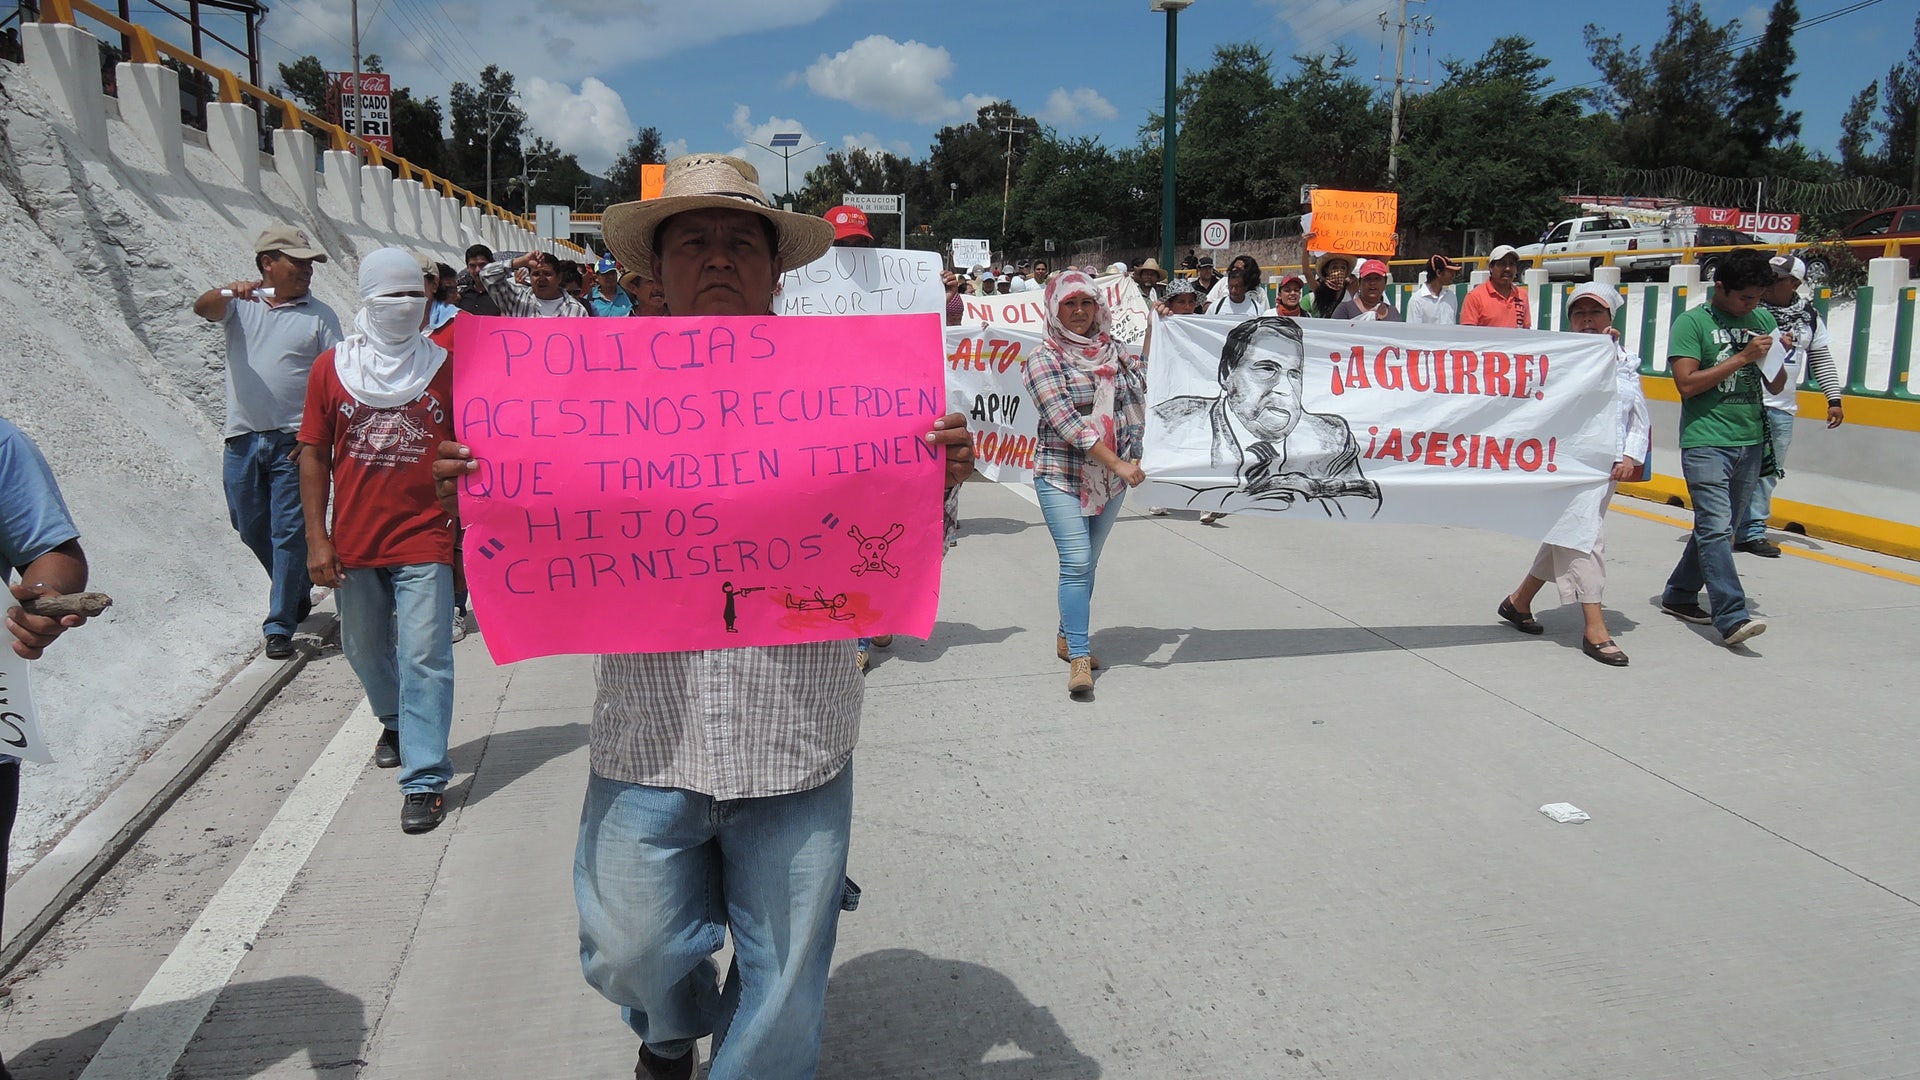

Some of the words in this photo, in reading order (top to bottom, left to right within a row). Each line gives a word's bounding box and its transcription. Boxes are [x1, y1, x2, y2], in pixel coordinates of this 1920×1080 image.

[343, 76, 386, 91] Co-Cola
[343, 95, 387, 110] MECADO
[344, 110, 366, 118] CO.
[1335, 200, 1349, 209] NO
[1352, 200, 1373, 209] HAY
[1374, 195, 1395, 210] PAZ
[1355, 210, 1396, 225] PUEBLO
[1210, 227, 1221, 238] 70
[1332, 238, 1395, 252] GOBIERNO
[783, 252, 932, 287] AGUIRRE
[870, 288, 916, 311] TU
[966, 302, 994, 323] NI
[1514, 296, 1525, 330] AERO
[490, 323, 776, 376] POLICIAS
[947, 338, 1022, 374] ALTO
[1329, 345, 1550, 400] ¡AGUIRRE!
[463, 395, 706, 439] ACESINOS
[712, 385, 937, 427] RECUERDEN
[1363, 426, 1558, 473] ¡ASESINO!
[465, 456, 553, 498] QUE
[584, 448, 779, 492] TAMBIEN
[798, 435, 938, 477] TIENEN
[526, 503, 720, 543] HIJOS
